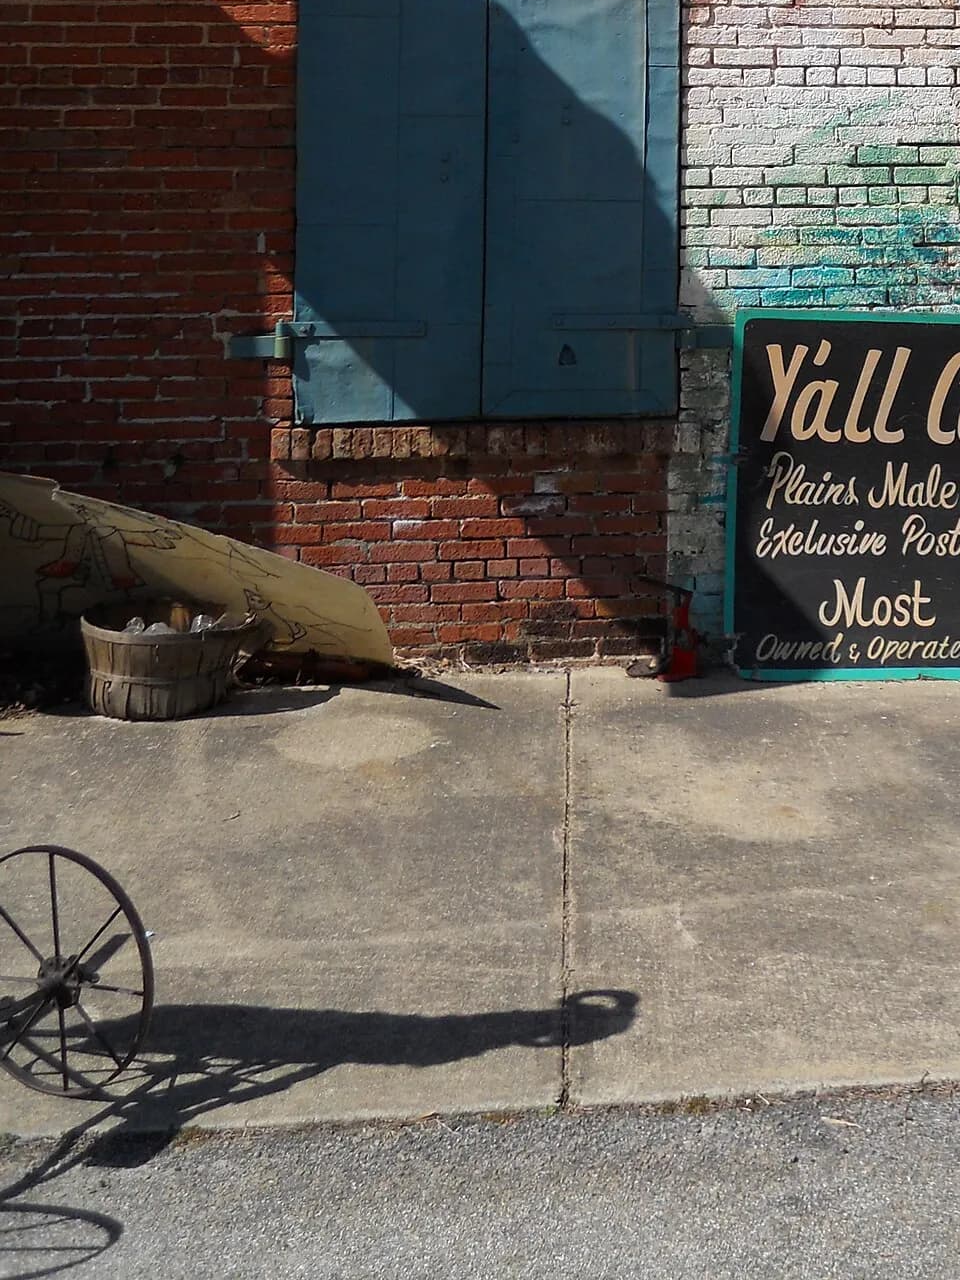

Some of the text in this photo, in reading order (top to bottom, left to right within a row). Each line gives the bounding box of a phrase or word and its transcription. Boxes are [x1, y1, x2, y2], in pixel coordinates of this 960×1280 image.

[766, 451, 859, 509] Plains
[868, 461, 959, 509] Male
[756, 518, 887, 559] Exclusive
[818, 577, 936, 628] Most
[755, 632, 844, 663] Owned
[849, 642, 861, 663] &
